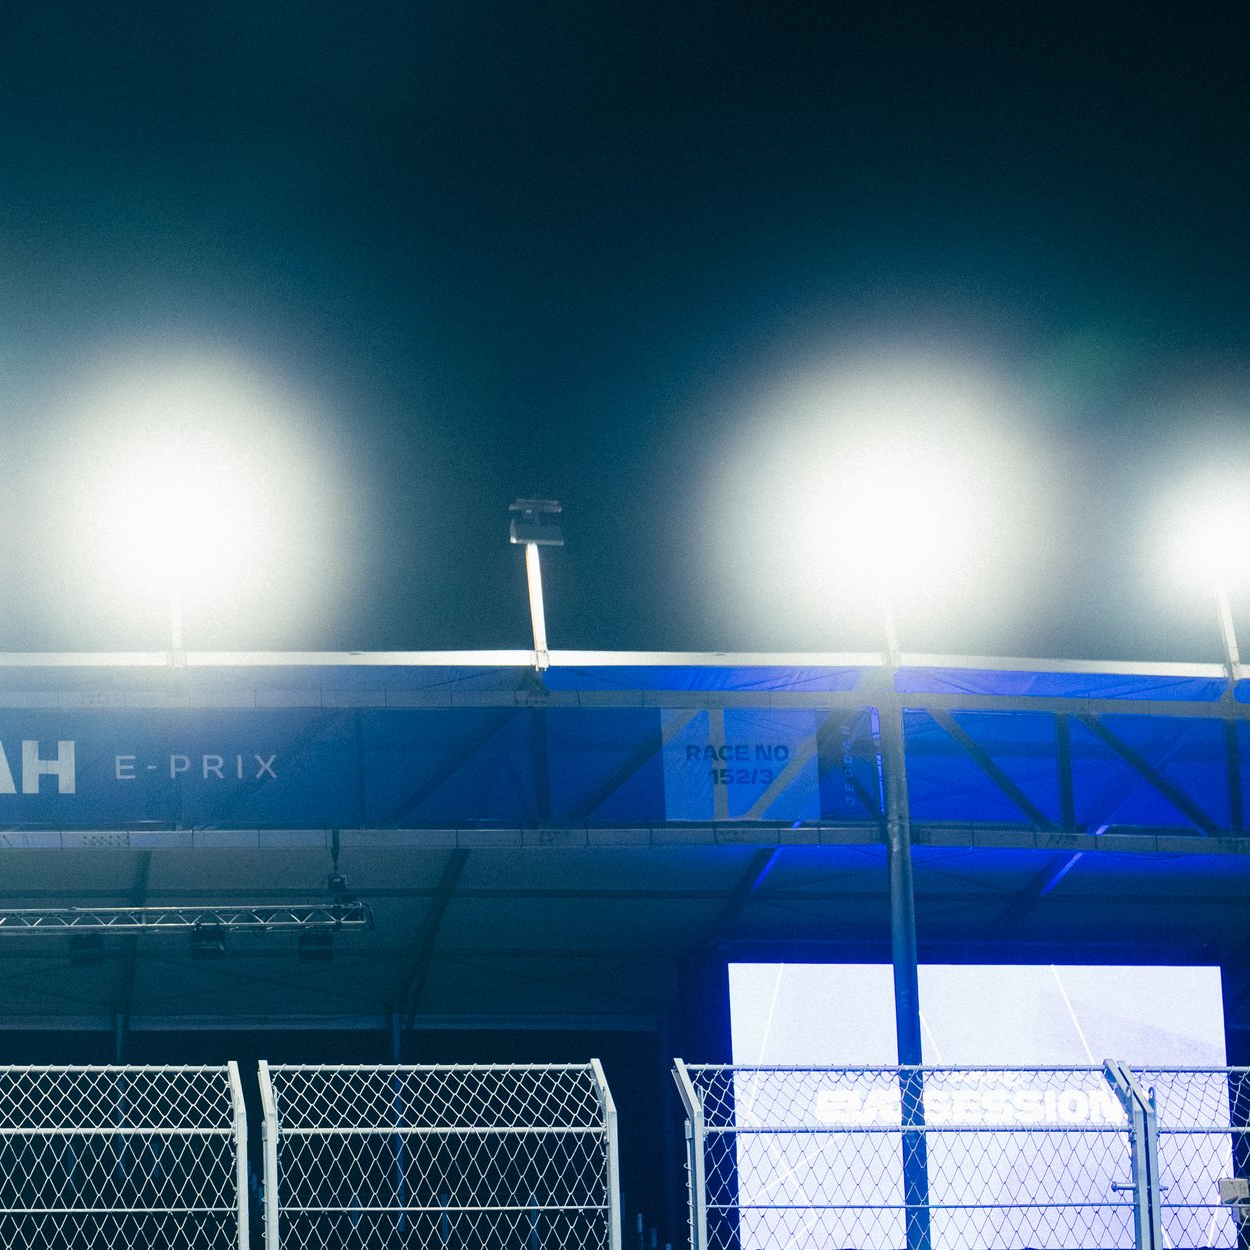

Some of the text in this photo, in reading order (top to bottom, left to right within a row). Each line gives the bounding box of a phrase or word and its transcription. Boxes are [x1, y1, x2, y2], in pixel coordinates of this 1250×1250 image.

[686, 744, 790, 762] RACE NO
[114, 754, 278, 781] E-PRIX
[707, 768, 774, 785] 152/3
